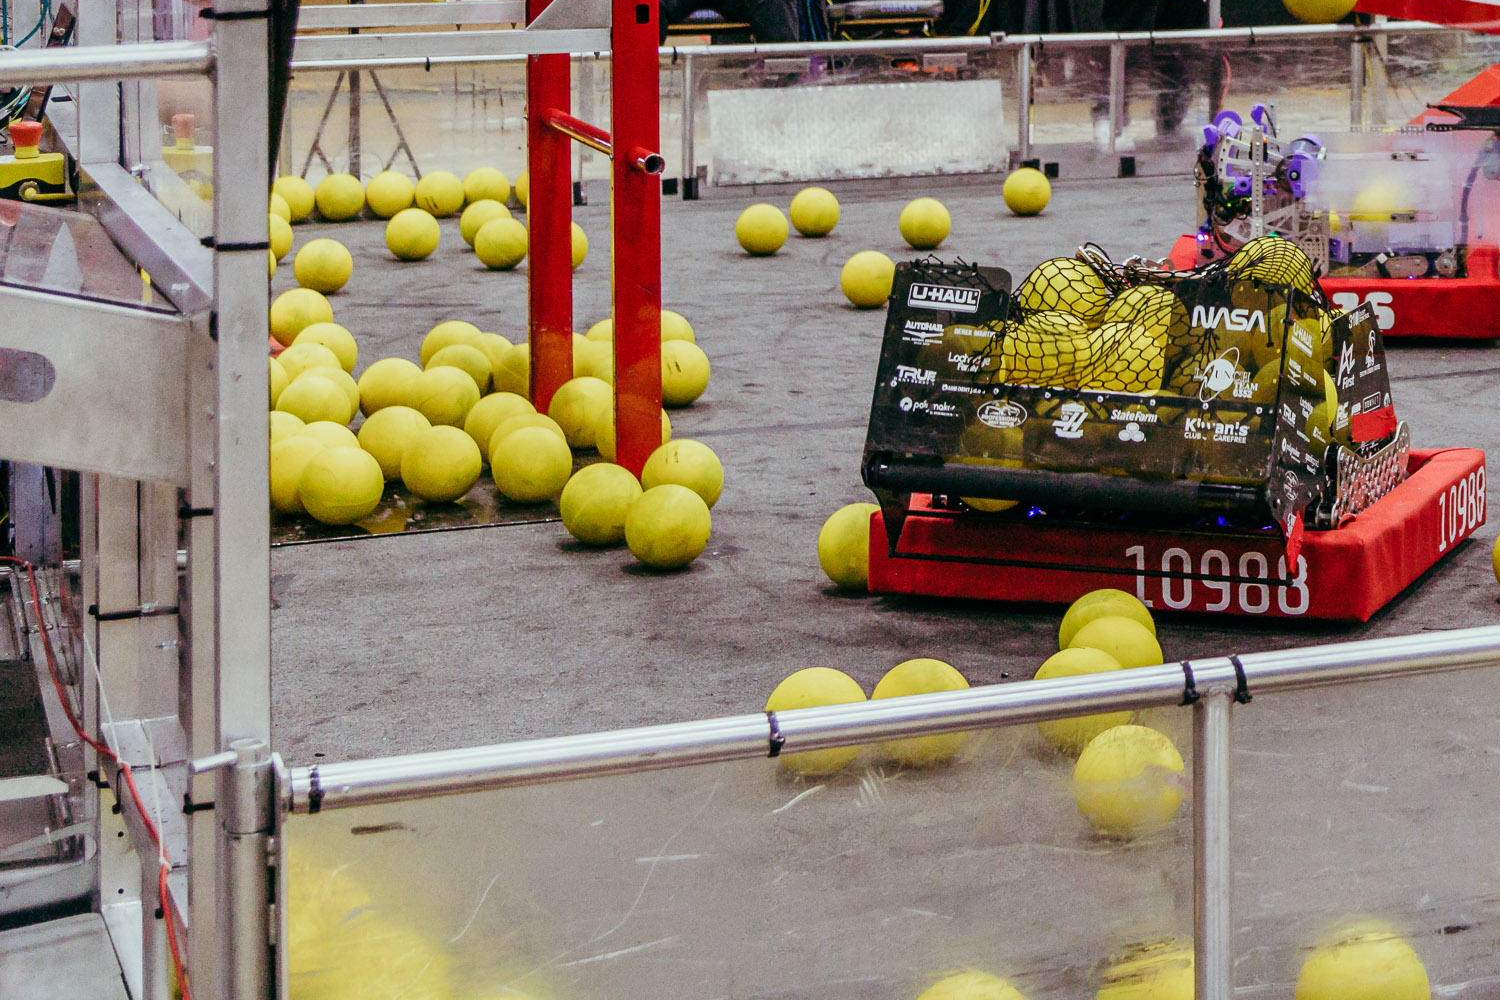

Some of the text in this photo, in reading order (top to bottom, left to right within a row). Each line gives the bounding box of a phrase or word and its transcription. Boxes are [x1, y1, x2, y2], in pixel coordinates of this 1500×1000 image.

[911, 285, 978, 305] U-HAUL
[905, 320, 944, 332] AUTOHAIL
[1191, 305, 1266, 333] NASA
[954, 328, 972, 336] DEREK
[897, 365, 937, 382] TRUE
[1234, 381, 1258, 391] TEAM
[1342, 375, 1355, 390] First
[1213, 434, 1247, 444] CAREFREE
[1438, 465, 1486, 552] 10988
[1125, 545, 1309, 615] 10988
